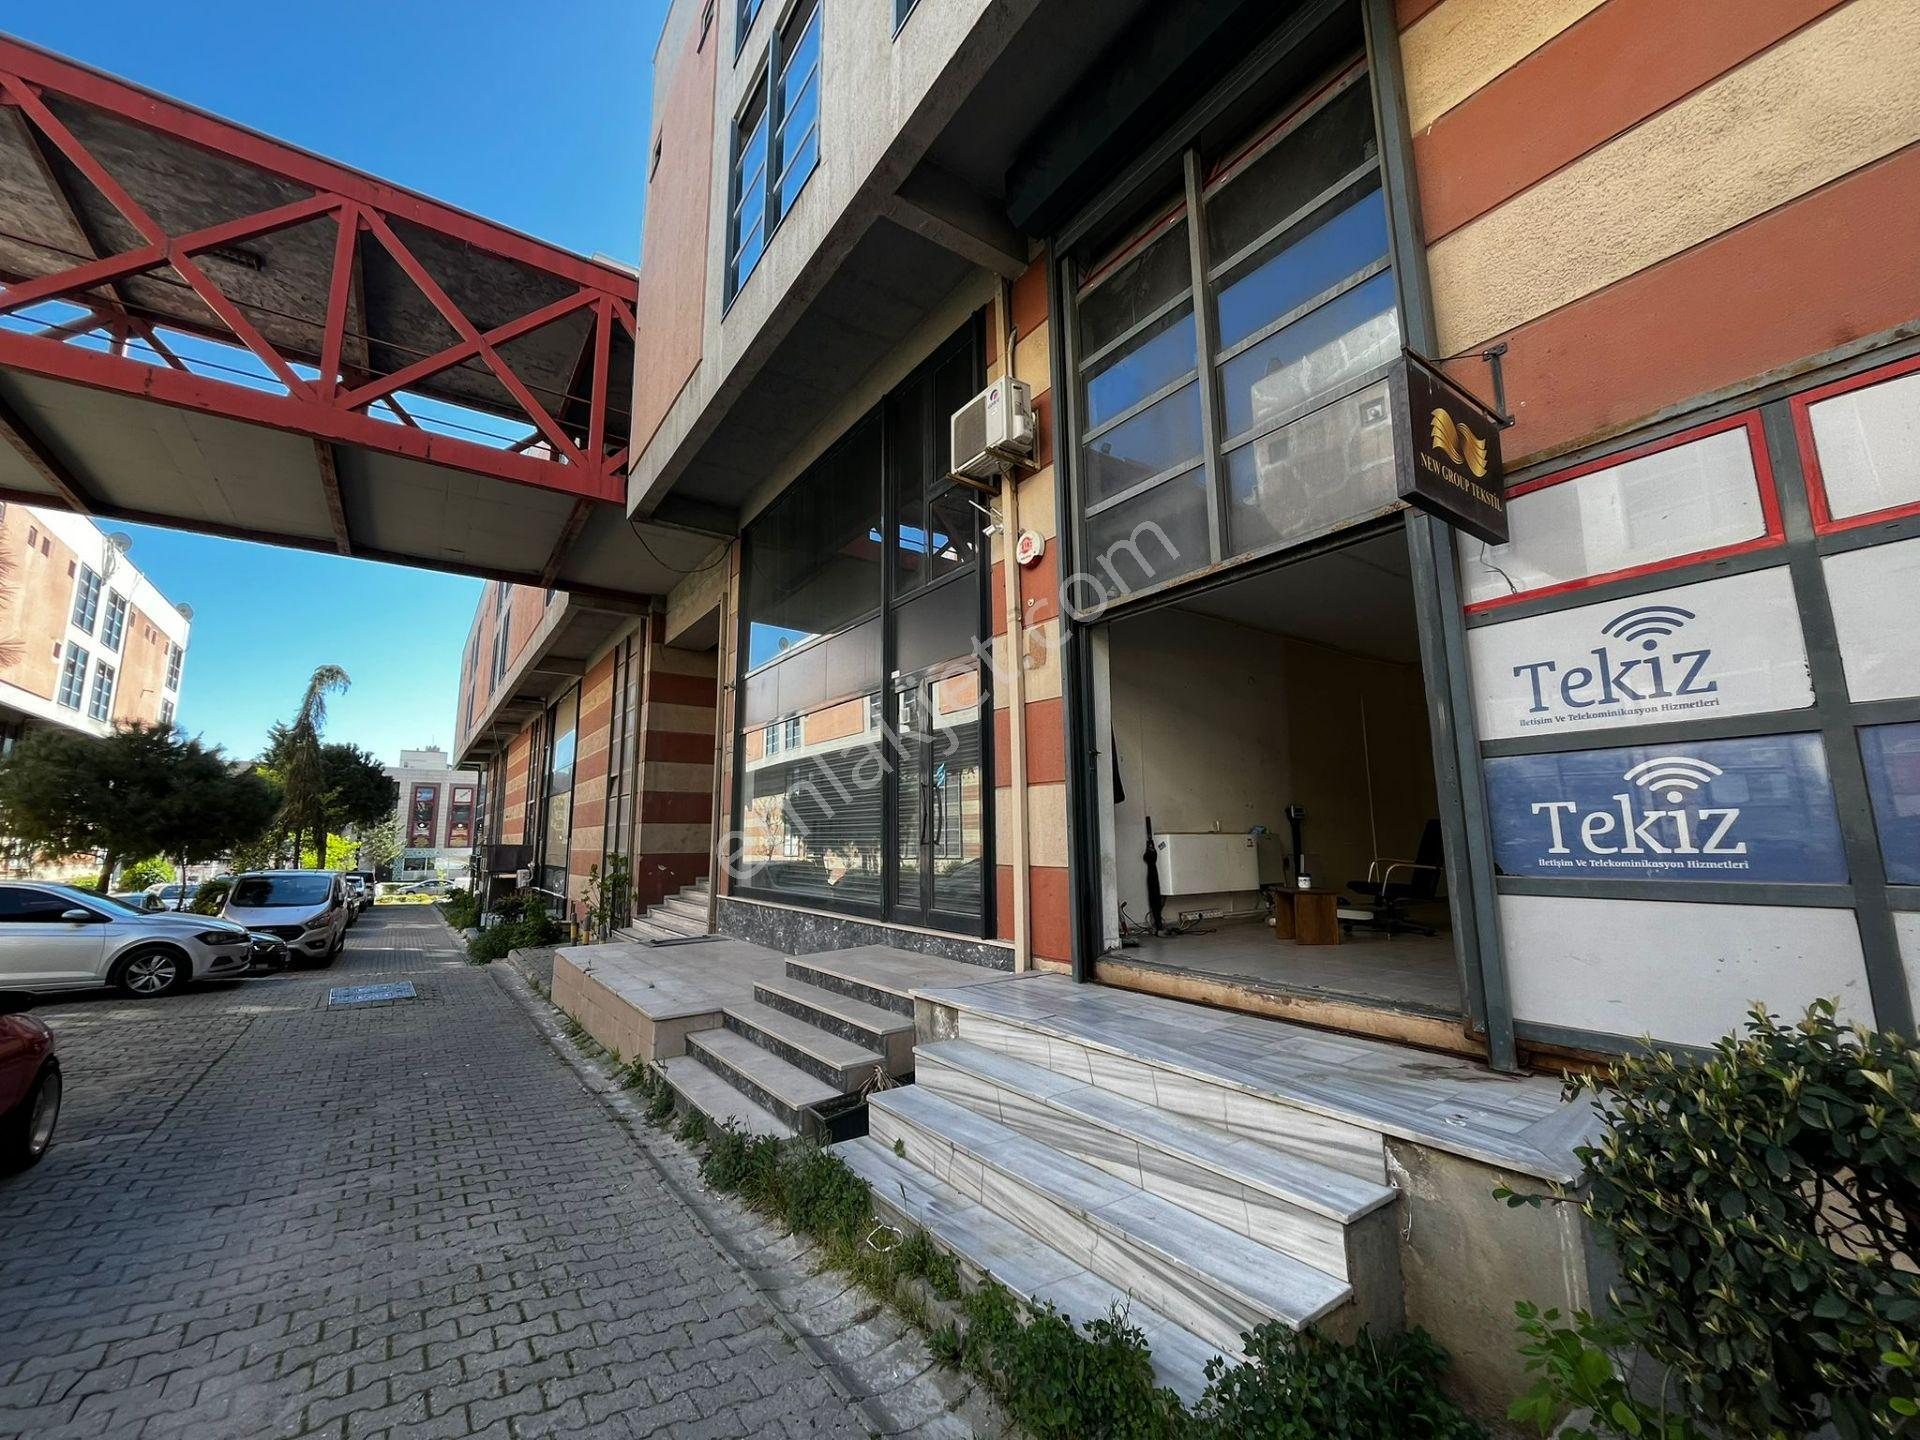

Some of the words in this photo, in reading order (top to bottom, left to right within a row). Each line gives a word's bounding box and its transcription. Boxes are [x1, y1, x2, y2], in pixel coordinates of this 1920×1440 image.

[1420, 451, 1443, 476] NEW
[1441, 465, 1470, 493] GROUP
[1470, 483, 1503, 512] TEKSTİL
[1513, 640, 1718, 713] Tekiz
[1554, 714, 1566, 723] Ve
[1567, 704, 1659, 722] Telekominikasyon
[1661, 697, 1720, 713] Hizmetleri
[1531, 791, 1747, 854] Tekiz
[1576, 859, 1587, 867] Ve
[1588, 858, 1685, 870] Telekominikasyon
[1687, 859, 1750, 869] Hizmetleri
